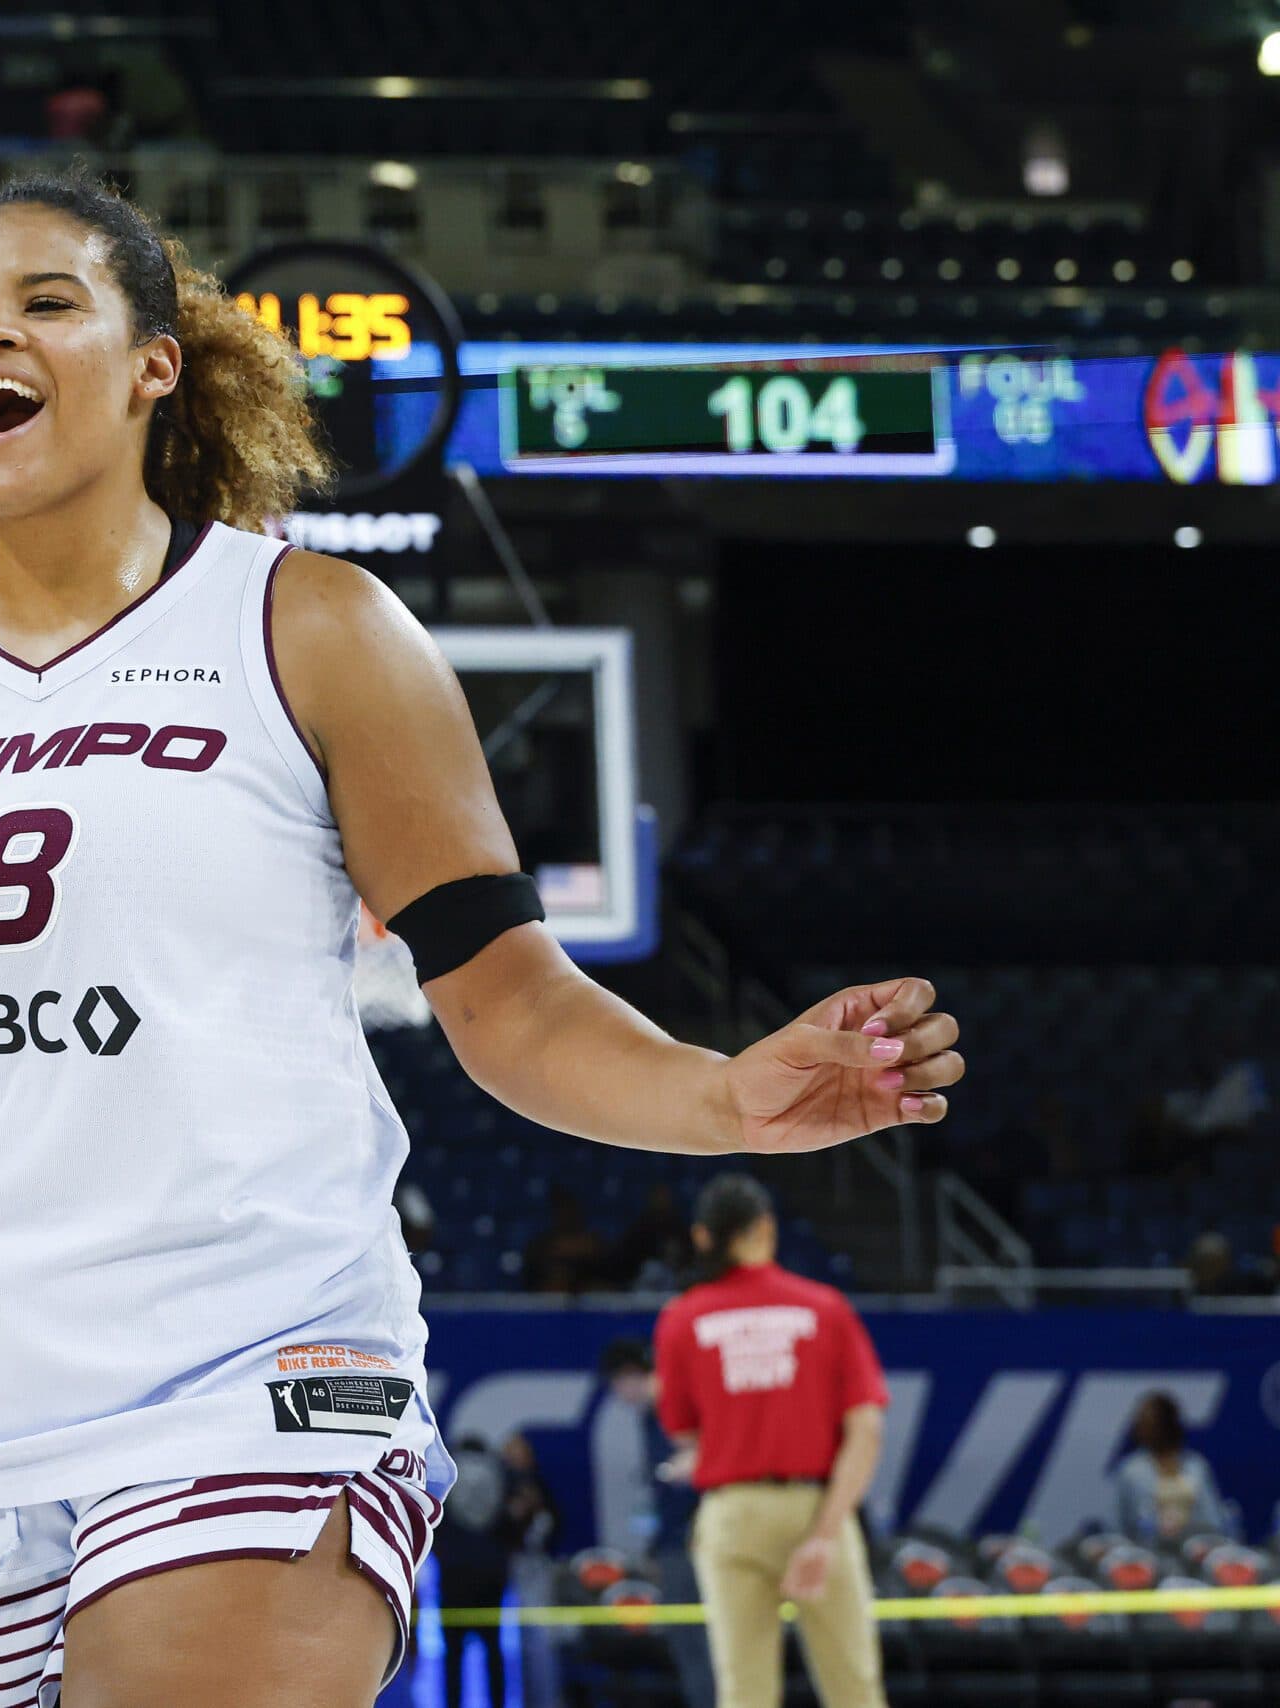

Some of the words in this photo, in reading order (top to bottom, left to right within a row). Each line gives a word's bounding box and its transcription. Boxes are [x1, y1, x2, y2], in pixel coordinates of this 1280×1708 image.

[708, 374, 866, 453] 104
[110, 667, 222, 685] SEPHORA
[277, 1344, 346, 1357] TORONTO
[276, 1357, 308, 1373] NIKE
[311, 1355, 352, 1370] REBEL
[311, 1387, 326, 1398] 46
